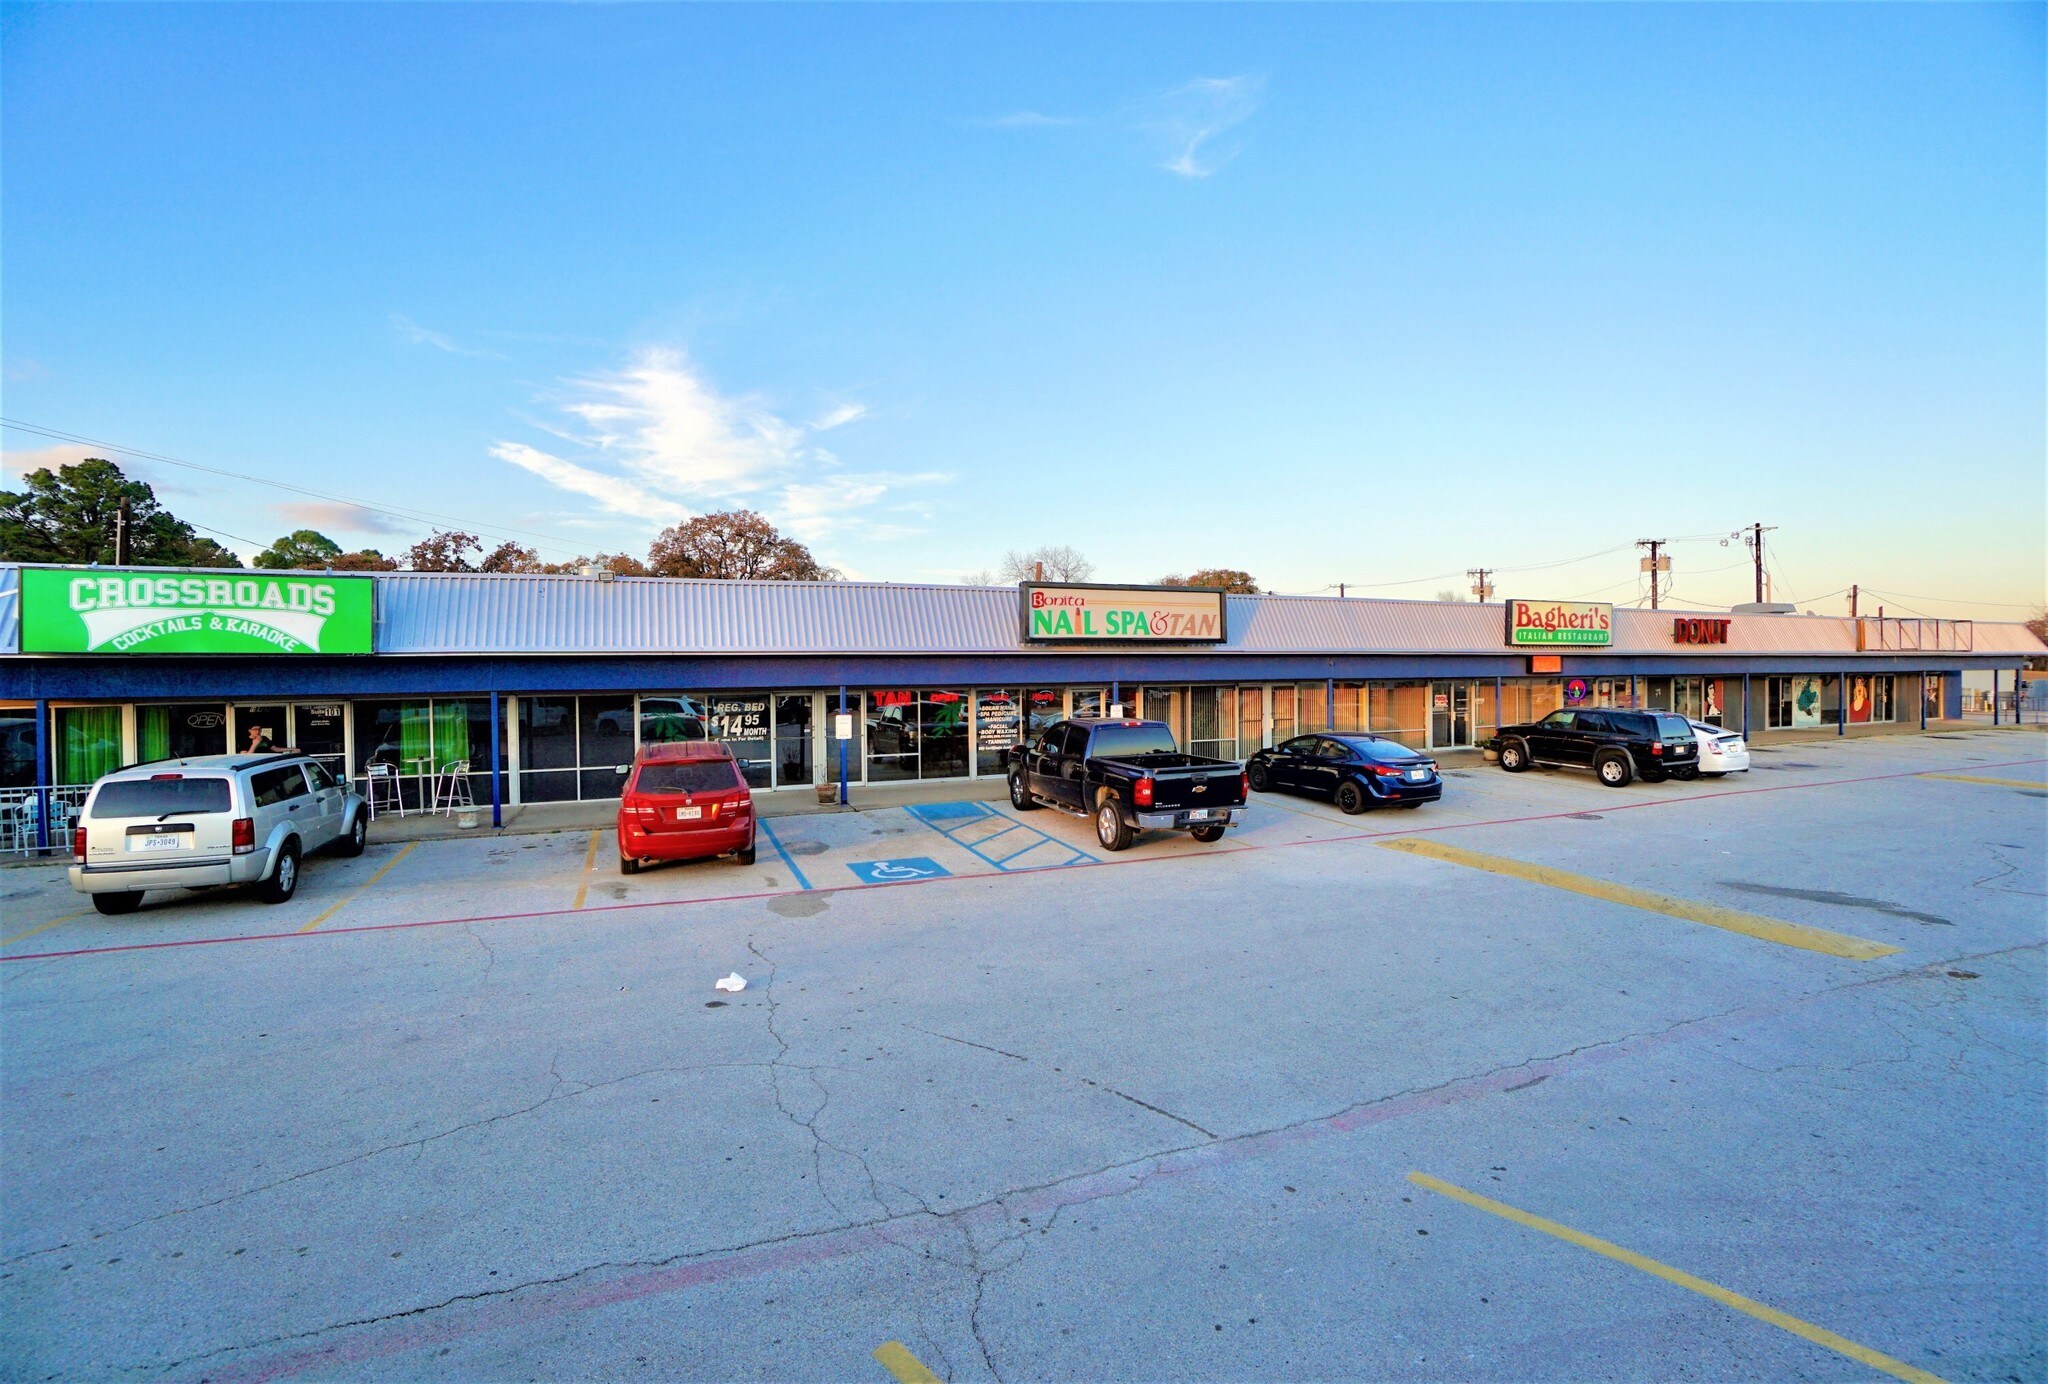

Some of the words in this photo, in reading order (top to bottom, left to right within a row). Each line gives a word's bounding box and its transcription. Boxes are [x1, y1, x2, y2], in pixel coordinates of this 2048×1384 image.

[69, 578, 336, 616] CROSSROADS
[1031, 592, 1085, 609] Bonita
[1034, 607, 1098, 635] NAIL
[1516, 603, 1609, 632] Bagheri's
[112, 617, 203, 651] COCKTAILS
[209, 618, 224, 629] &
[226, 620, 301, 652] KARAOKE
[1518, 629, 1553, 640] ITALIAN
[1557, 631, 1609, 642] RESTAURANT
[1674, 618, 1732, 644] DONUT
[873, 690, 912, 707] TAN
[930, 694, 958, 702] OPEN
[326, 708, 340, 716] 101
[718, 704, 740, 712] REG.
[744, 702, 764, 712] BED
[188, 714, 227, 726] OPEN
[744, 728, 768, 736] MONTH
